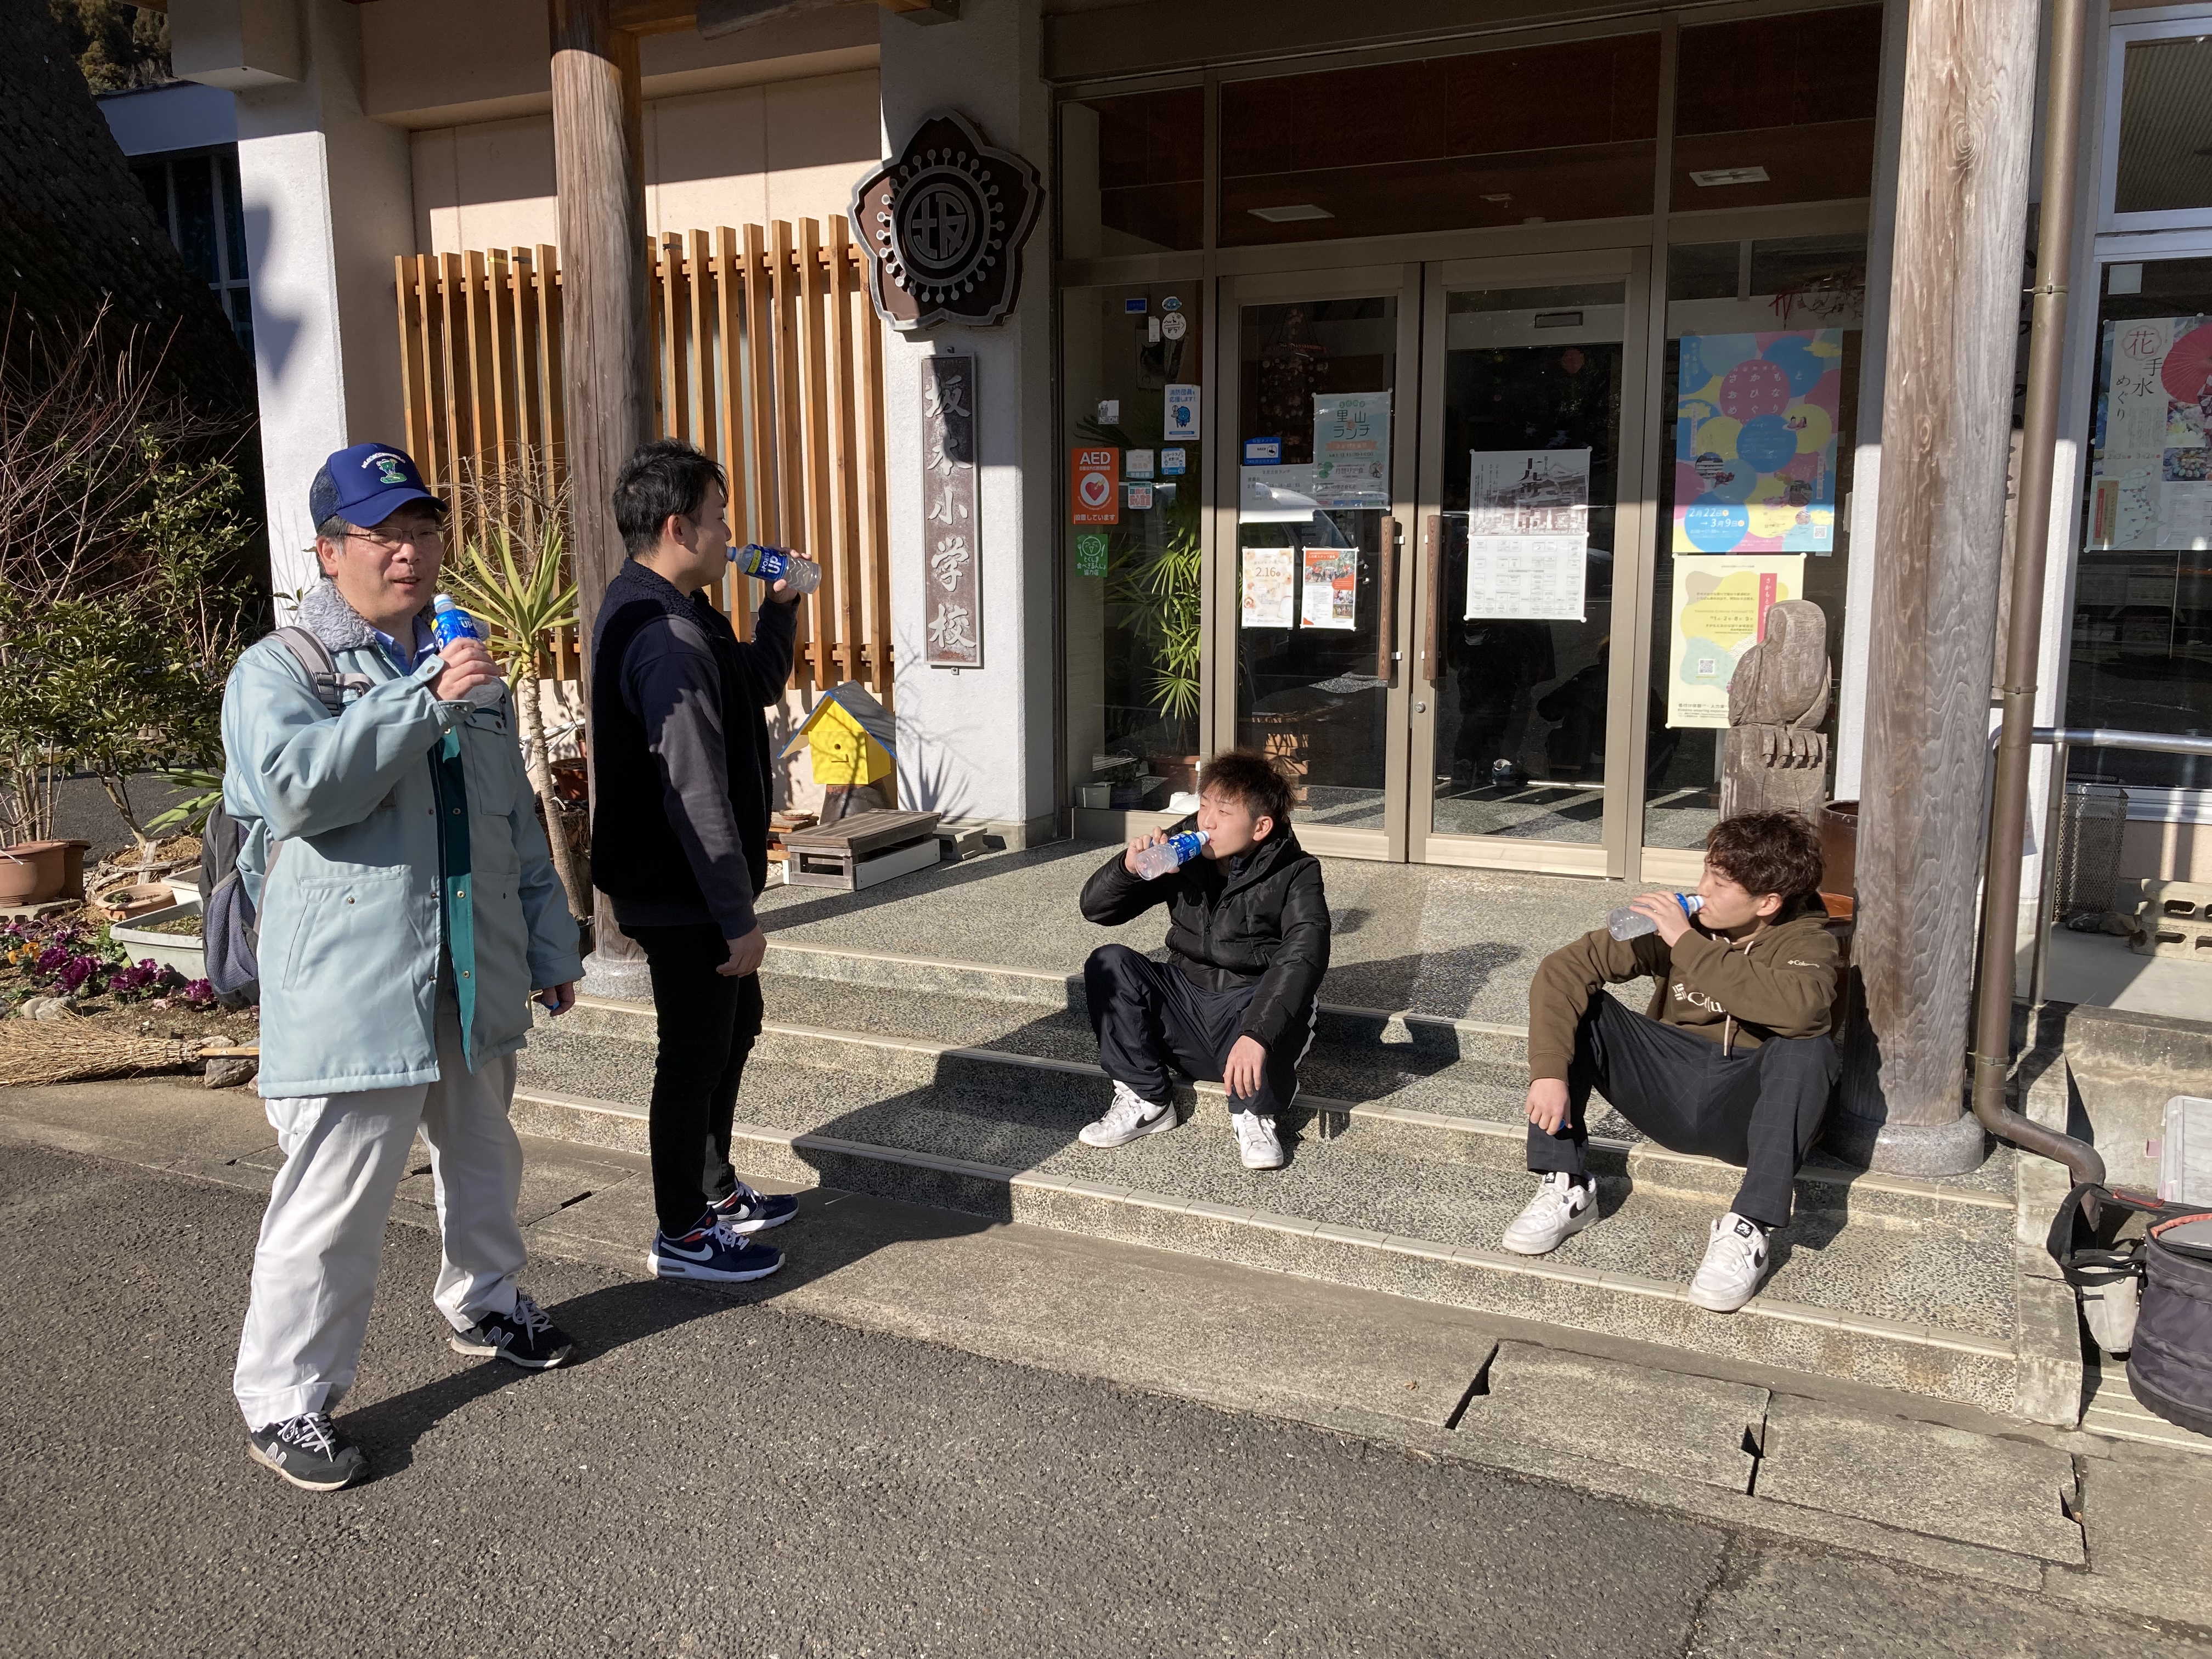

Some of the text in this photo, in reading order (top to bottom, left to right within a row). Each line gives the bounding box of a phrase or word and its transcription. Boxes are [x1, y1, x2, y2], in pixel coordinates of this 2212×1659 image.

[2126, 330, 2157, 356] 花
[2115, 375, 2131, 421] めぐり
[1336, 410, 1366, 423] 里山
[1334, 424, 1370, 439] ランチ
[1080, 452, 1111, 465] AED
[925, 375, 976, 648] 坂本小学校
[760, 552, 770, 573] SPORTS
[767, 556, 782, 574] UP
[1255, 567, 1276, 577] 2.16
[460, 620, 473, 629] UP
